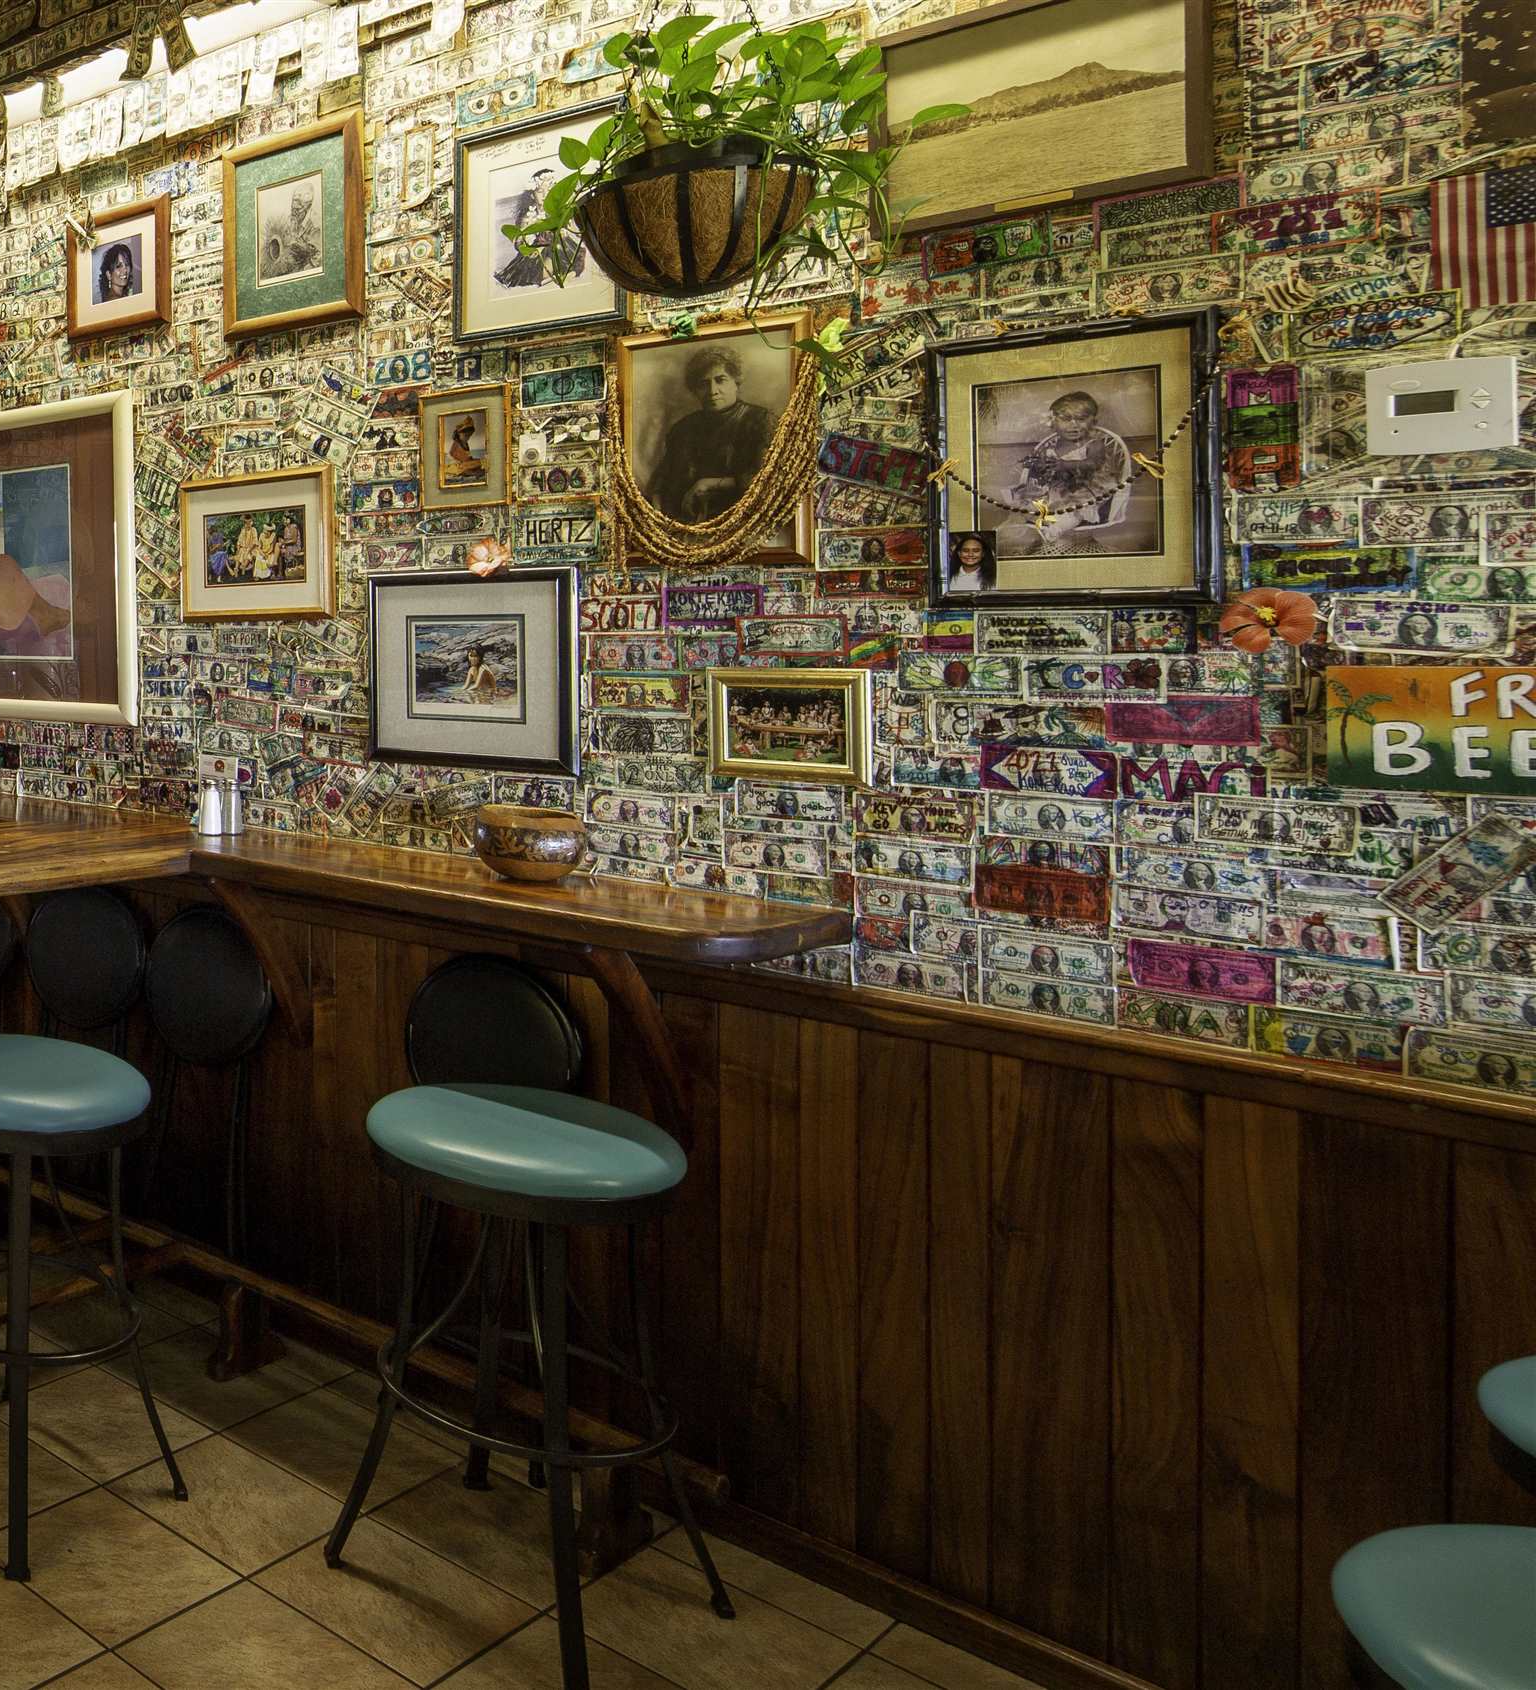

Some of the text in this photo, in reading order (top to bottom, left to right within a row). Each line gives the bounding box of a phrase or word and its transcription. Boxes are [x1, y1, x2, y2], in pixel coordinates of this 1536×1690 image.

[1266, 17, 1306, 47] NEW
[1312, 27, 1385, 59] 2018
[1312, 318, 1425, 342] LAS VEGAS
[525, 517, 595, 546] HERTZ
[223, 632, 238, 644] HEY
[1372, 720, 1536, 779] BEE
[644, 769, 677, 784] ONE
[872, 802, 897, 815] KEV
[872, 819, 891, 829] GO
